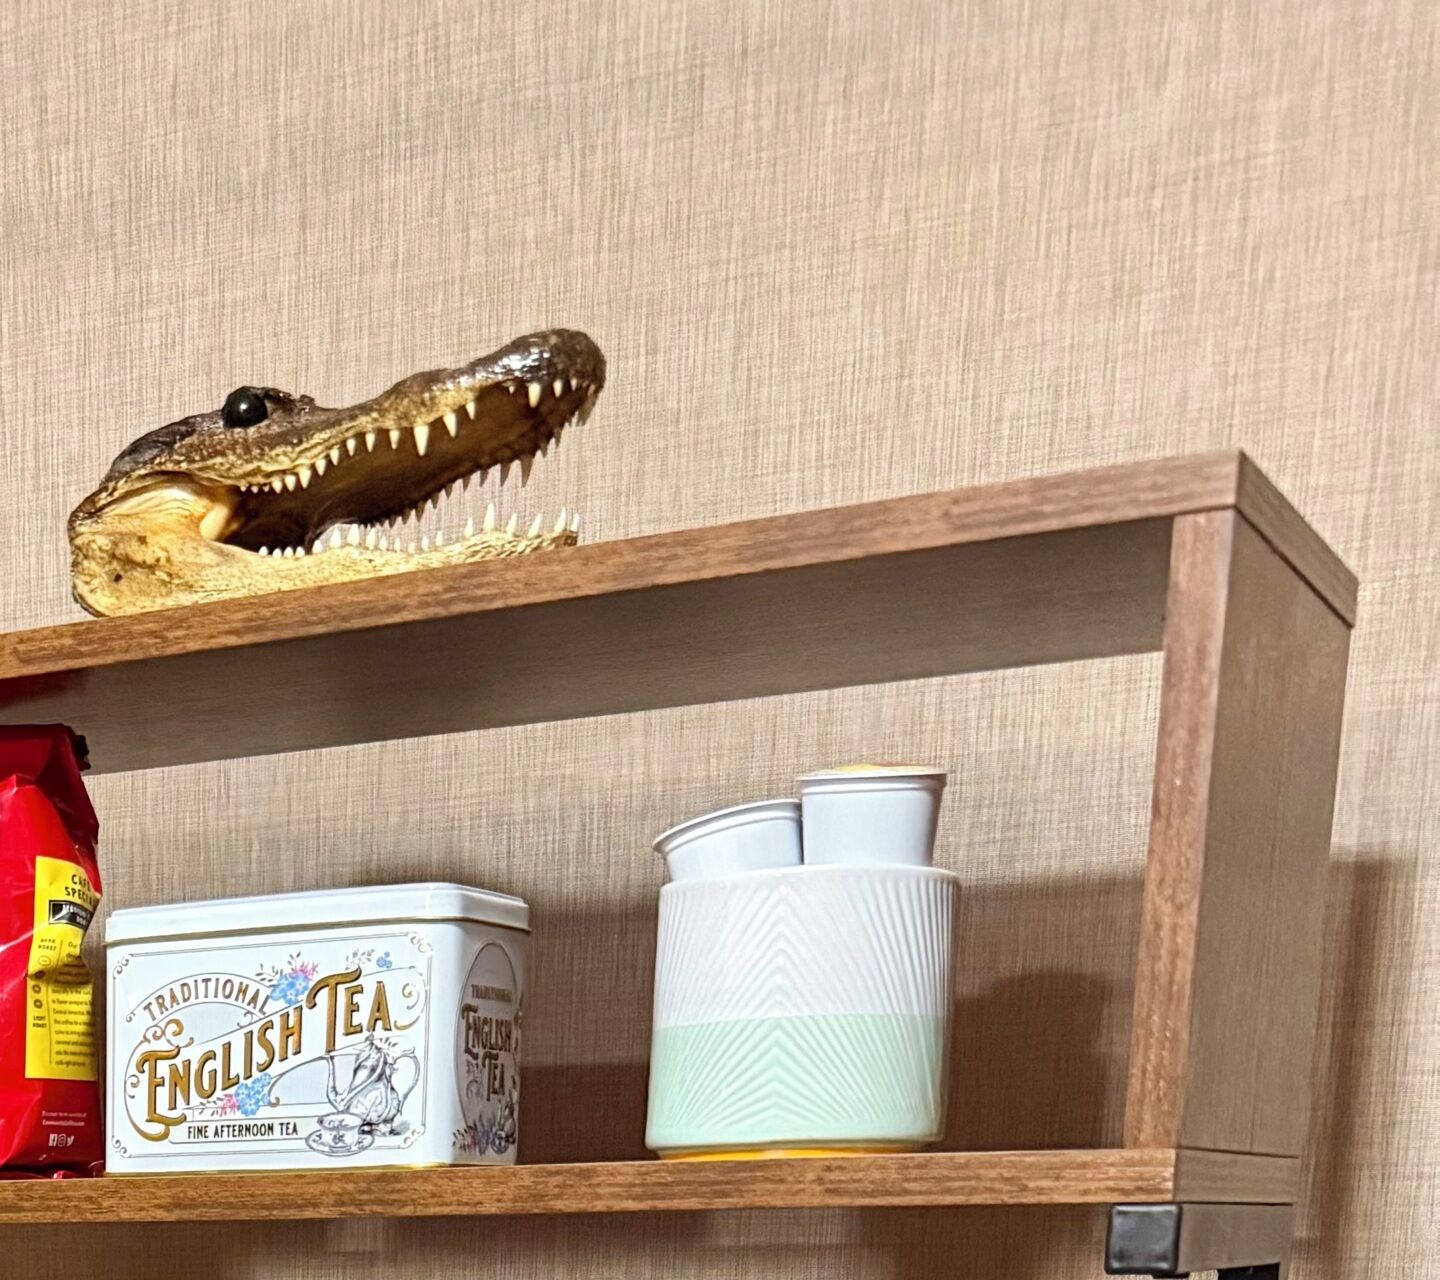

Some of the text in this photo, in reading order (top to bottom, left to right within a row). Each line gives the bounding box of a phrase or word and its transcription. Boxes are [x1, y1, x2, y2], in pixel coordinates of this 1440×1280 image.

[143, 982, 271, 1022] TRADITIONAL
[136, 1005, 303, 1128] ENGLISH
[306, 965, 394, 1053] TEA
[462, 1003, 512, 1060] ENGLISH
[482, 1050, 505, 1102] TEA
[187, 1120, 299, 1140] FINE AFTERNOON TEA
